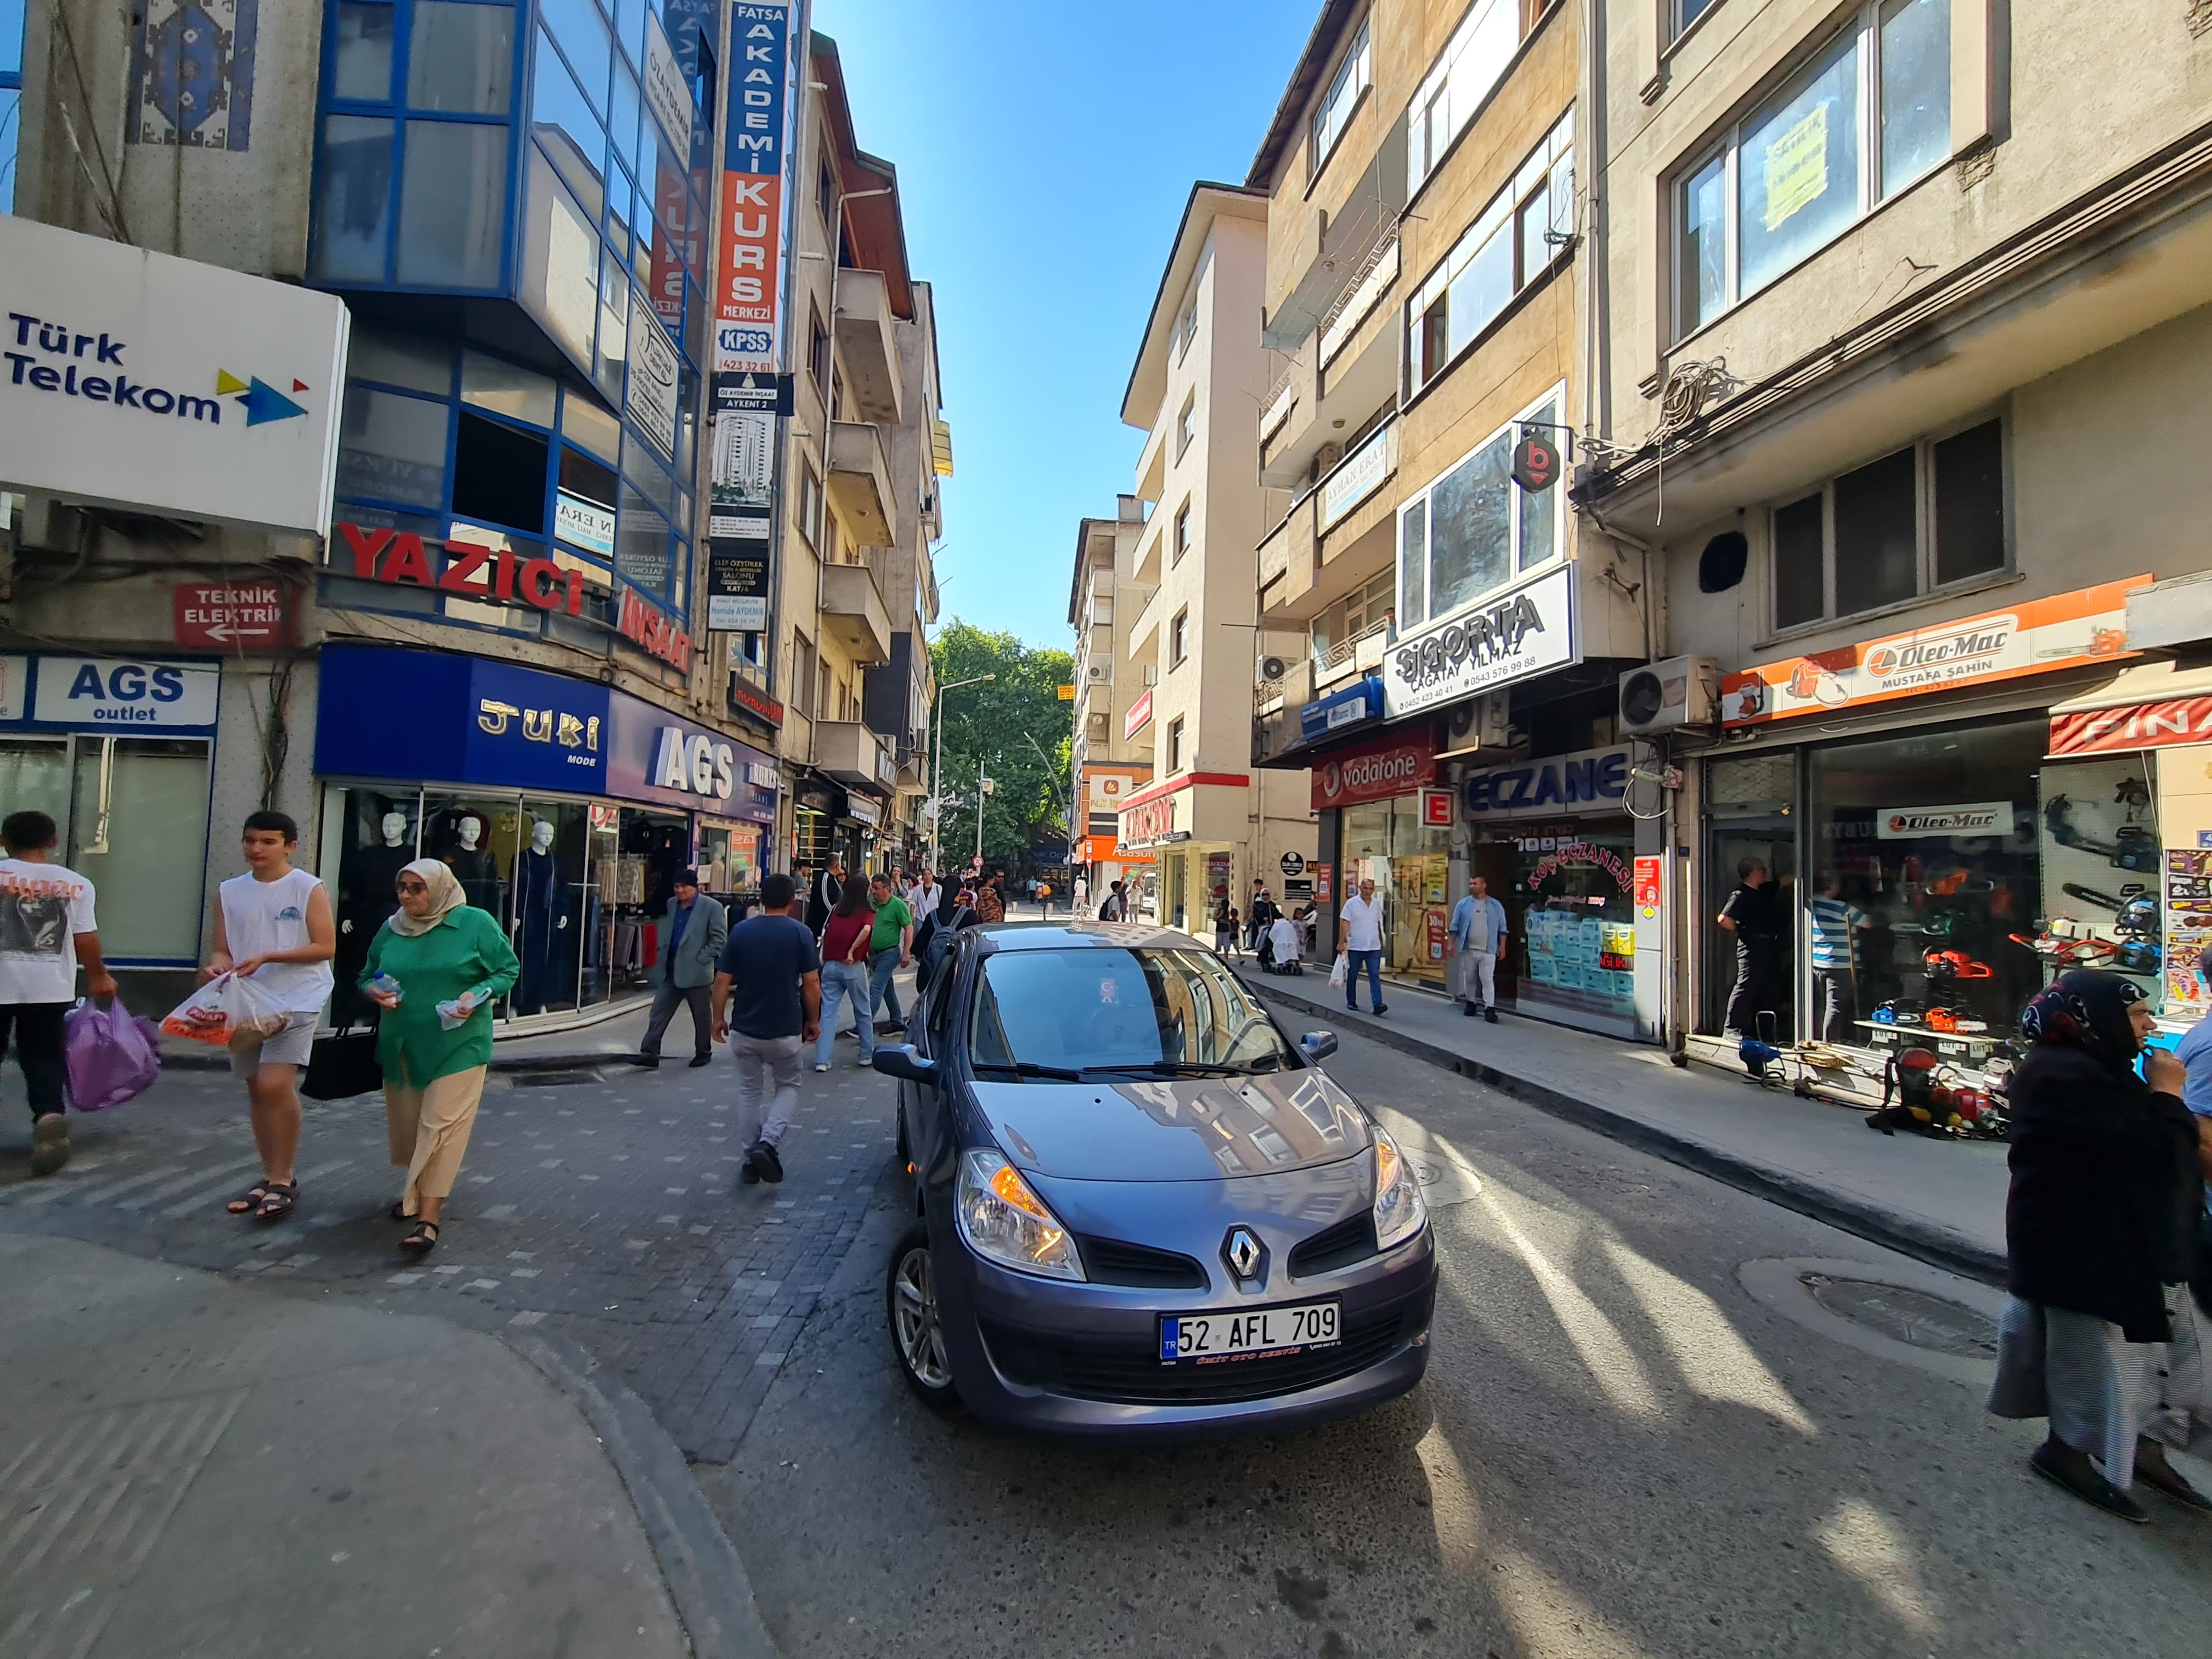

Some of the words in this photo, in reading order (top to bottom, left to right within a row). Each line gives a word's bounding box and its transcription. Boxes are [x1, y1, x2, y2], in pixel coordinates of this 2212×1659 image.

[738, 5, 783, 21] FATSA
[738, 24, 774, 174] AKADEMİ
[731, 179, 769, 302] KURS
[723, 304, 771, 320] MERKEZİ
[9, 312, 127, 367] Türk
[724, 331, 768, 351] KPSS
[723, 359, 743, 370] 423
[746, 361, 758, 371] 32
[4, 352, 220, 425] Telekom
[727, 400, 760, 408] AYKENT
[337, 521, 582, 616] YAZICI
[196, 586, 277, 604] TEKNİK
[1899, 632, 2008, 668] Oleo-Mac
[67, 664, 184, 702] AGS
[1471, 672, 1491, 686] 0543
[1492, 666, 1508, 679] 576
[1510, 661, 1522, 673] 99
[1524, 656, 1536, 668] 88
[1882, 670, 1941, 690] MUSTAFA
[1946, 659, 1993, 679] ŞAHİN
[1421, 691, 1434, 703] 423
[1434, 689, 1443, 699] 40
[93, 706, 156, 721] outlet
[567, 755, 596, 767] MODE
[654, 726, 733, 800] AGS
[1344, 755, 1417, 787] vodafone
[1468, 753, 1628, 813] ECZANE
[1430, 796, 1447, 821] E
[1909, 814, 1995, 829] Oleo-Mac
[1527, 854, 1557, 891] KOÇ
[1178, 1320, 1210, 1353] 52
[1229, 1315, 1275, 1348] AFL
[1292, 1307, 1336, 1341] 709
[1165, 1341, 1176, 1351] TR
